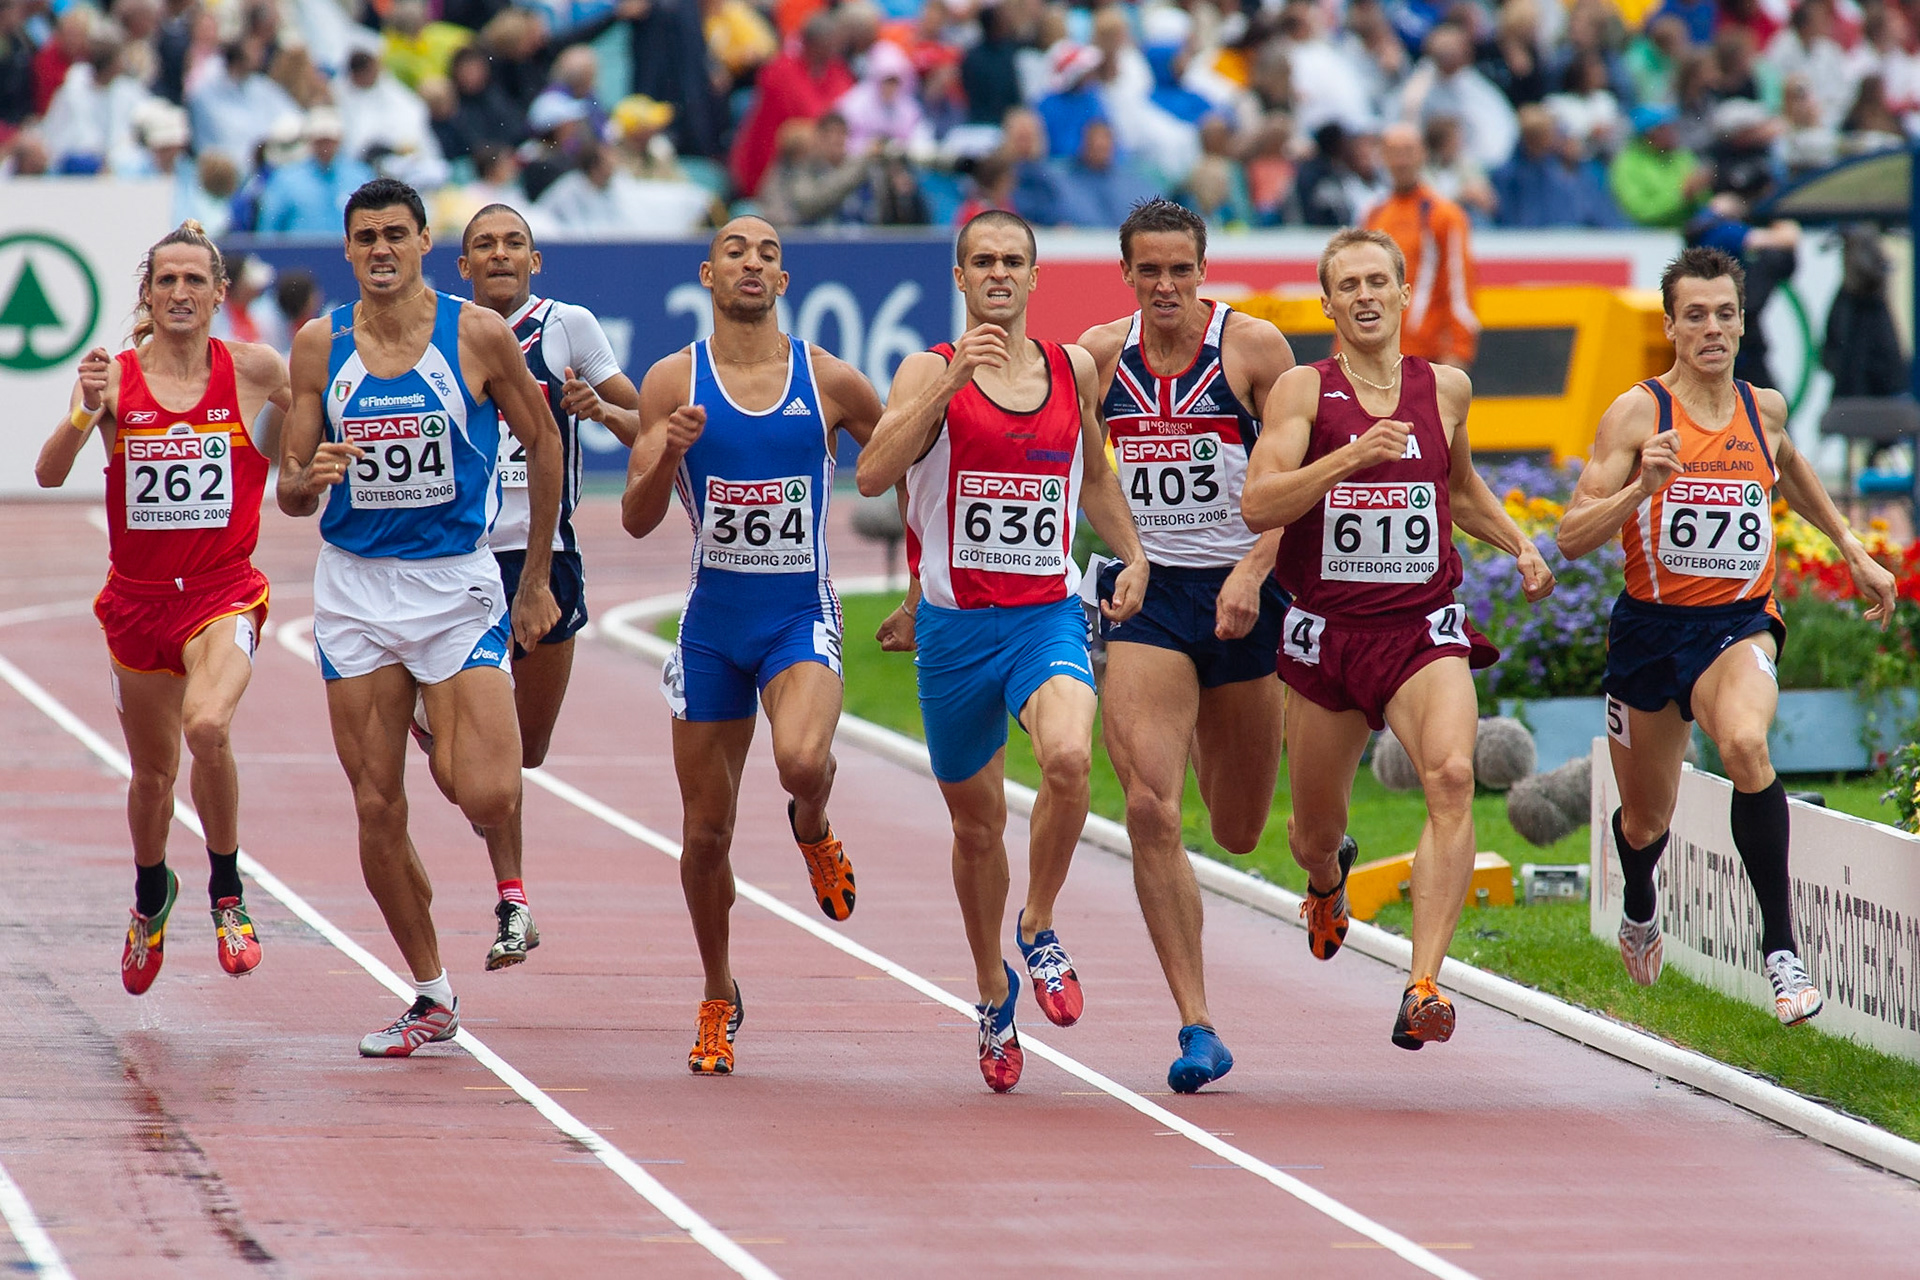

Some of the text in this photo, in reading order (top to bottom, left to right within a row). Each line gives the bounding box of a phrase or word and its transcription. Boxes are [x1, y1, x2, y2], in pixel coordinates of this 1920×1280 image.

[368, 393, 425, 407] Findomestic
[1193, 404, 1220, 414] adidas
[207, 409, 230, 421] ESP
[782, 407, 811, 416] adidas
[346, 419, 419, 439] SPAR
[1151, 421, 1193, 430] NORWICH
[130, 440, 200, 459] SPAR
[1124, 442, 1190, 460] SPAR
[356, 441, 446, 483] 594
[1683, 460, 1754, 473] NEDERLAND
[135, 464, 225, 504] 262
[356, 485, 454, 501] GÖTEBORG 2006
[711, 482, 782, 503] SPAR
[963, 477, 1040, 498] SPAR
[1130, 465, 1220, 506] 403
[1669, 483, 1742, 503] SPAR
[1332, 488, 1407, 506] SPAR
[132, 508, 230, 522] GÖTEBORG 2006
[965, 502, 1057, 547] 636
[1199, 509, 1228, 523] 2006
[712, 507, 805, 546] 364
[1333, 512, 1431, 554] 619
[1670, 508, 1762, 551] 678
[708, 550, 811, 566] GÖTEBORG 2006
[959, 549, 1061, 567] GÖTEBORG 2006
[1328, 559, 1435, 573] GÖTEBORG 2006
[1663, 554, 1737, 570] GÖTEBORG
[1438, 608, 1458, 639] 4
[1291, 617, 1314, 654] 4
[1608, 698, 1623, 735] 5
[1834, 865, 1907, 1029] GÖTEBORG
